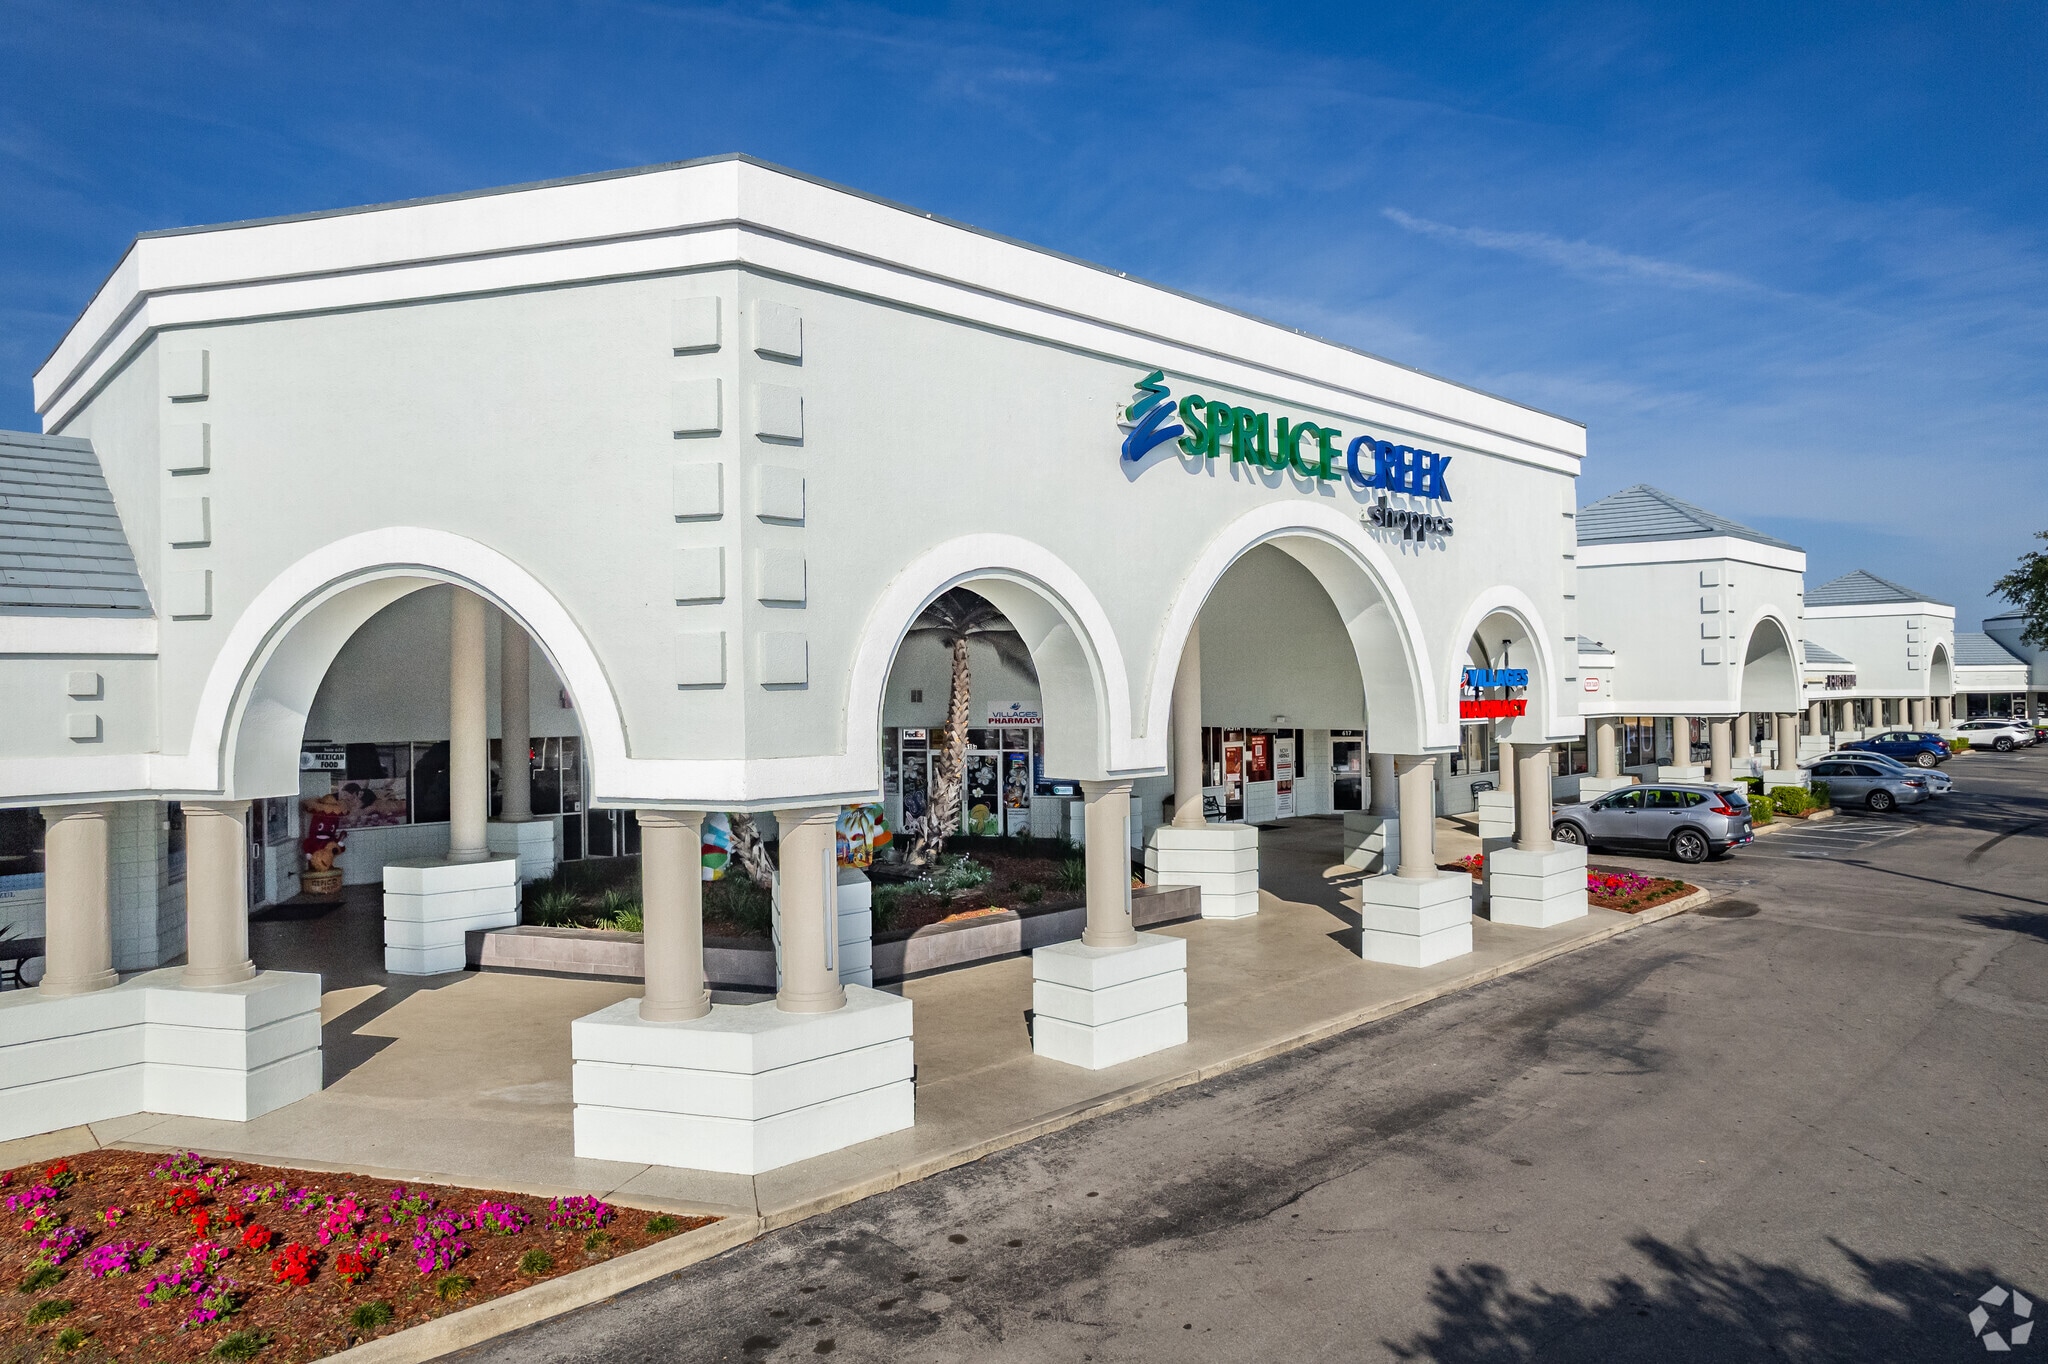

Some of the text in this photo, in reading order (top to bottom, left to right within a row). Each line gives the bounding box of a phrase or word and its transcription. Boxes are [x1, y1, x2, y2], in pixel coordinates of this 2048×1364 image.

[1178, 394, 1453, 502] SPRUCE CREEK
[1367, 496, 1454, 542] shoppes
[1466, 668, 1529, 687] VILLAGES
[1460, 699, 1528, 719] HARMACY
[988, 717, 1042, 725] PHARMACY
